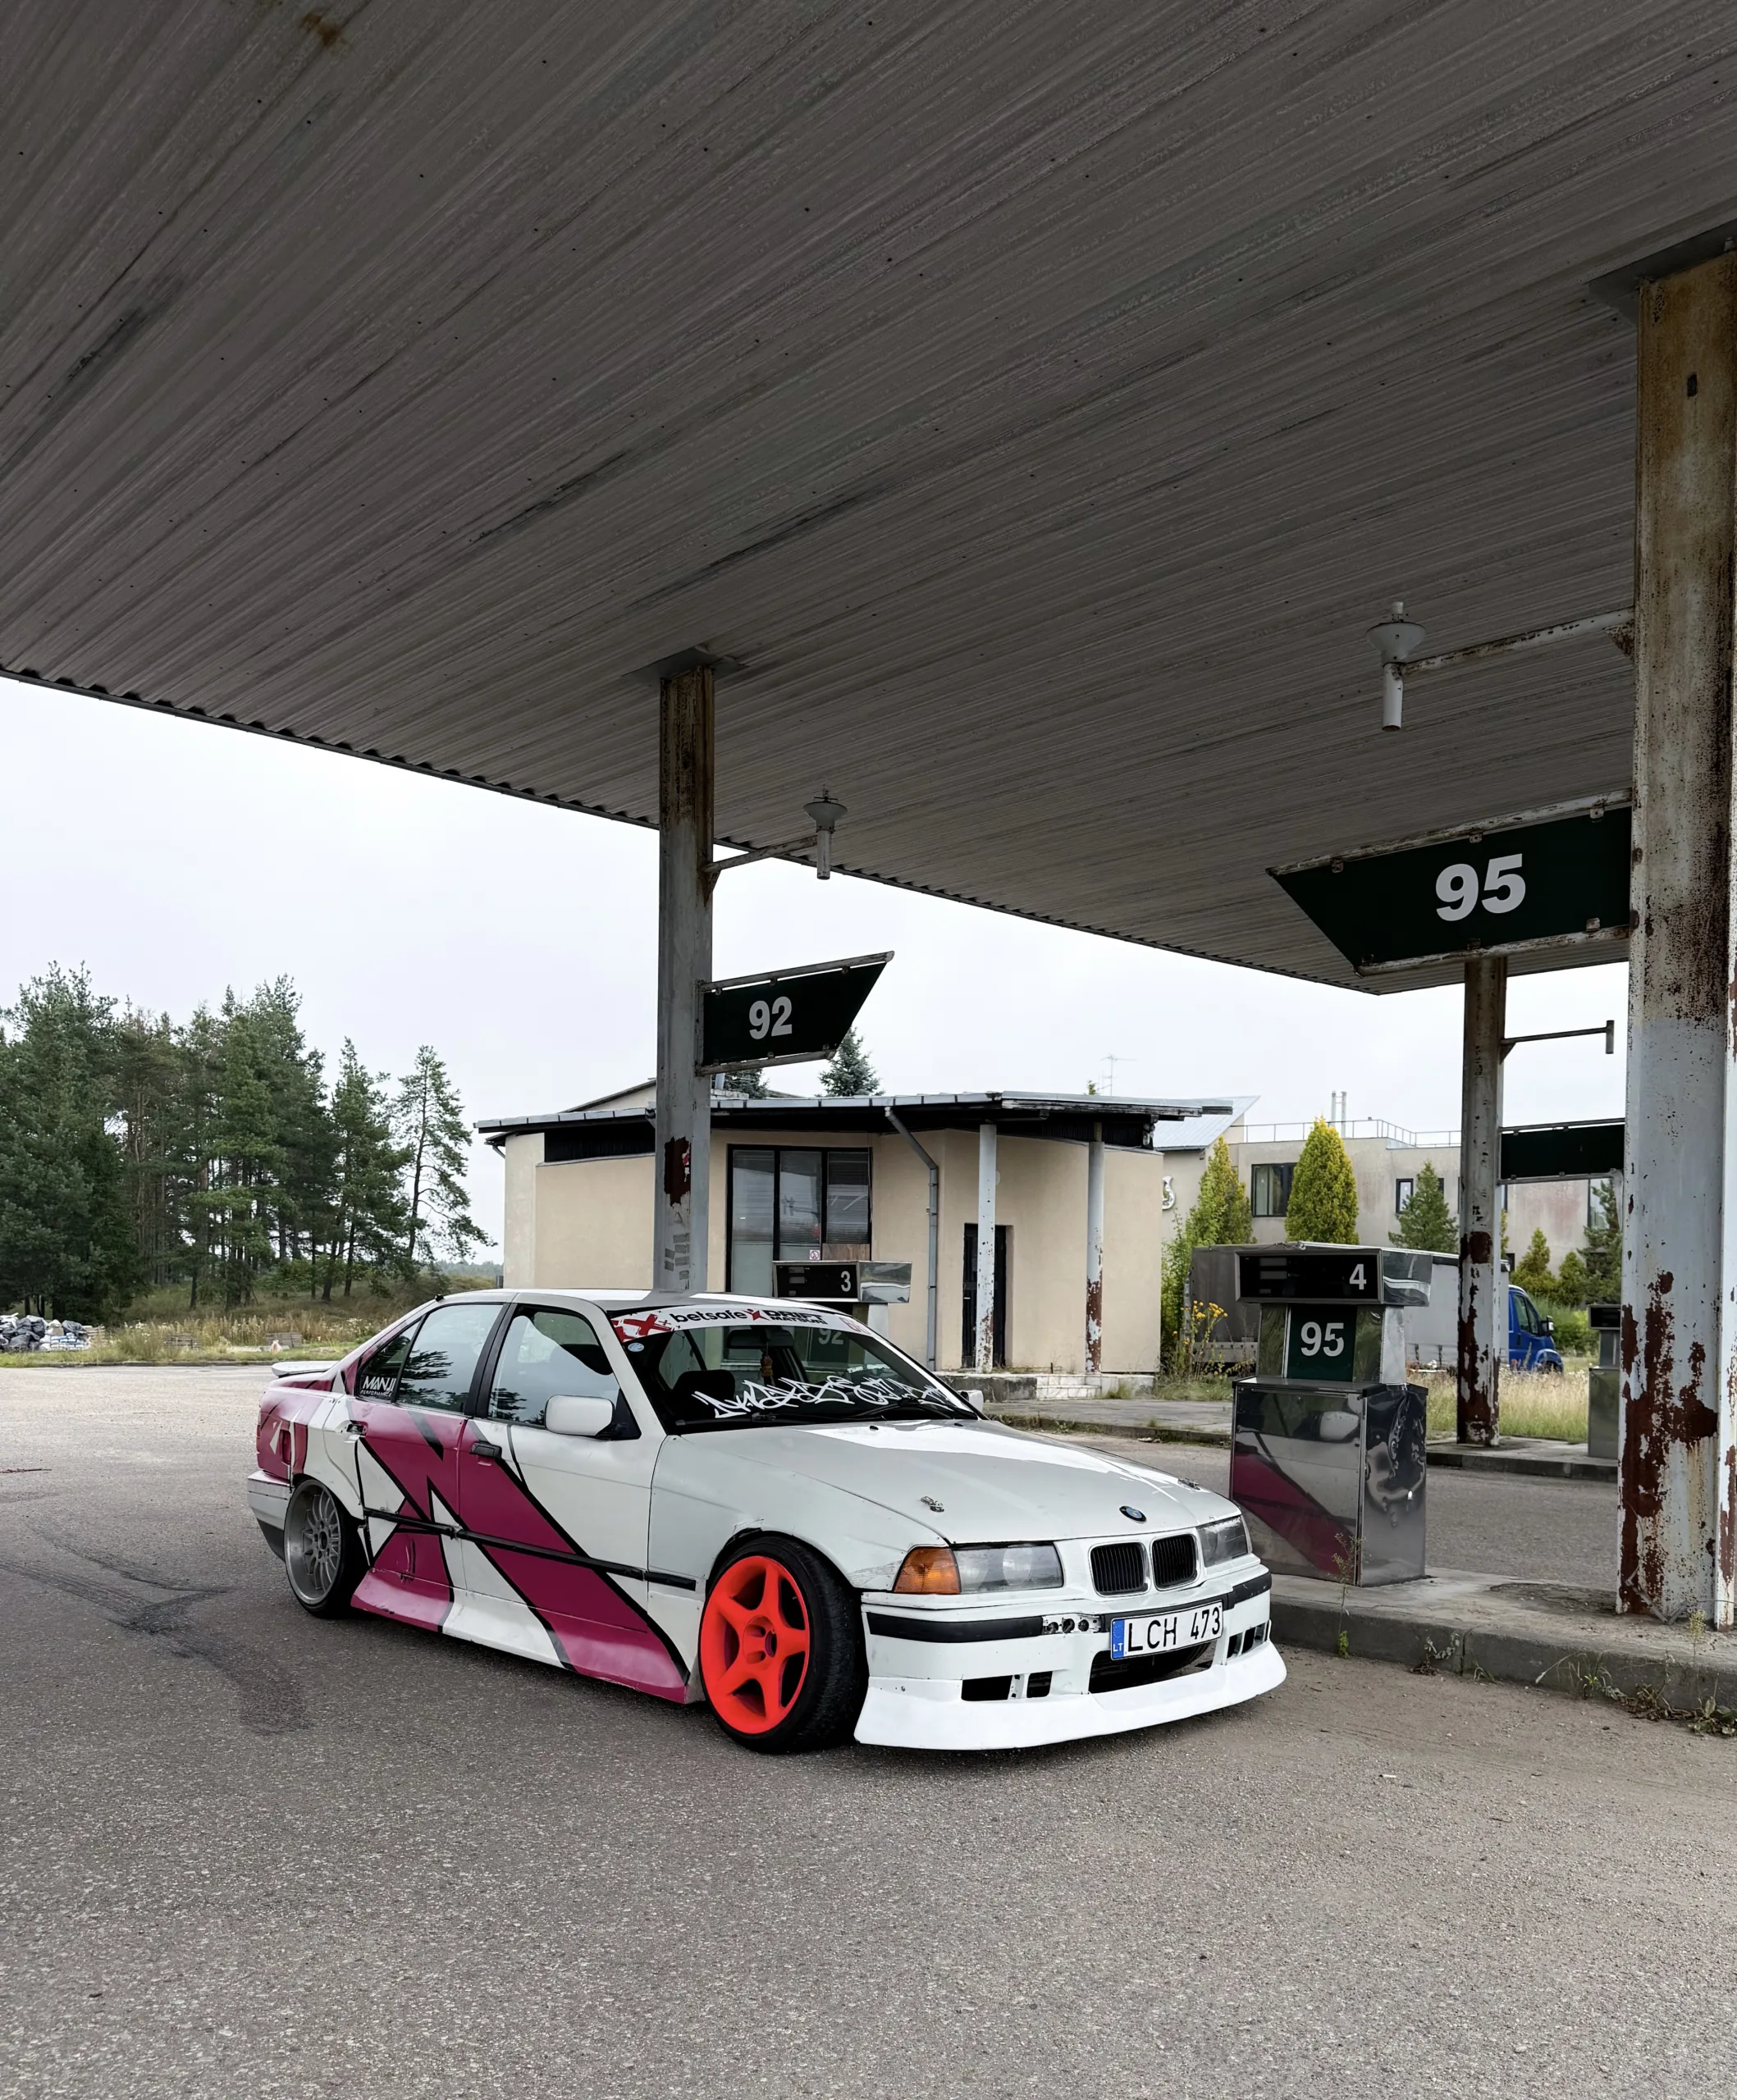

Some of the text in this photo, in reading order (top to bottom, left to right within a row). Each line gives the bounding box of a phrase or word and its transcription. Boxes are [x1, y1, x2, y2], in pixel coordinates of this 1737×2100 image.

[1435, 853, 1526, 921] 95
[749, 996, 793, 1039] 92
[840, 1271, 852, 1292] 3
[1349, 1263, 1367, 1290] 4
[670, 1310, 748, 1322] betsafe
[761, 1310, 823, 1320] DRIFT
[1300, 1322, 1345, 1357] 95
[362, 1376, 397, 1391] MANJI
[1127, 1607, 1221, 1652] LCH 473
[1113, 1643, 1122, 1653] LT
